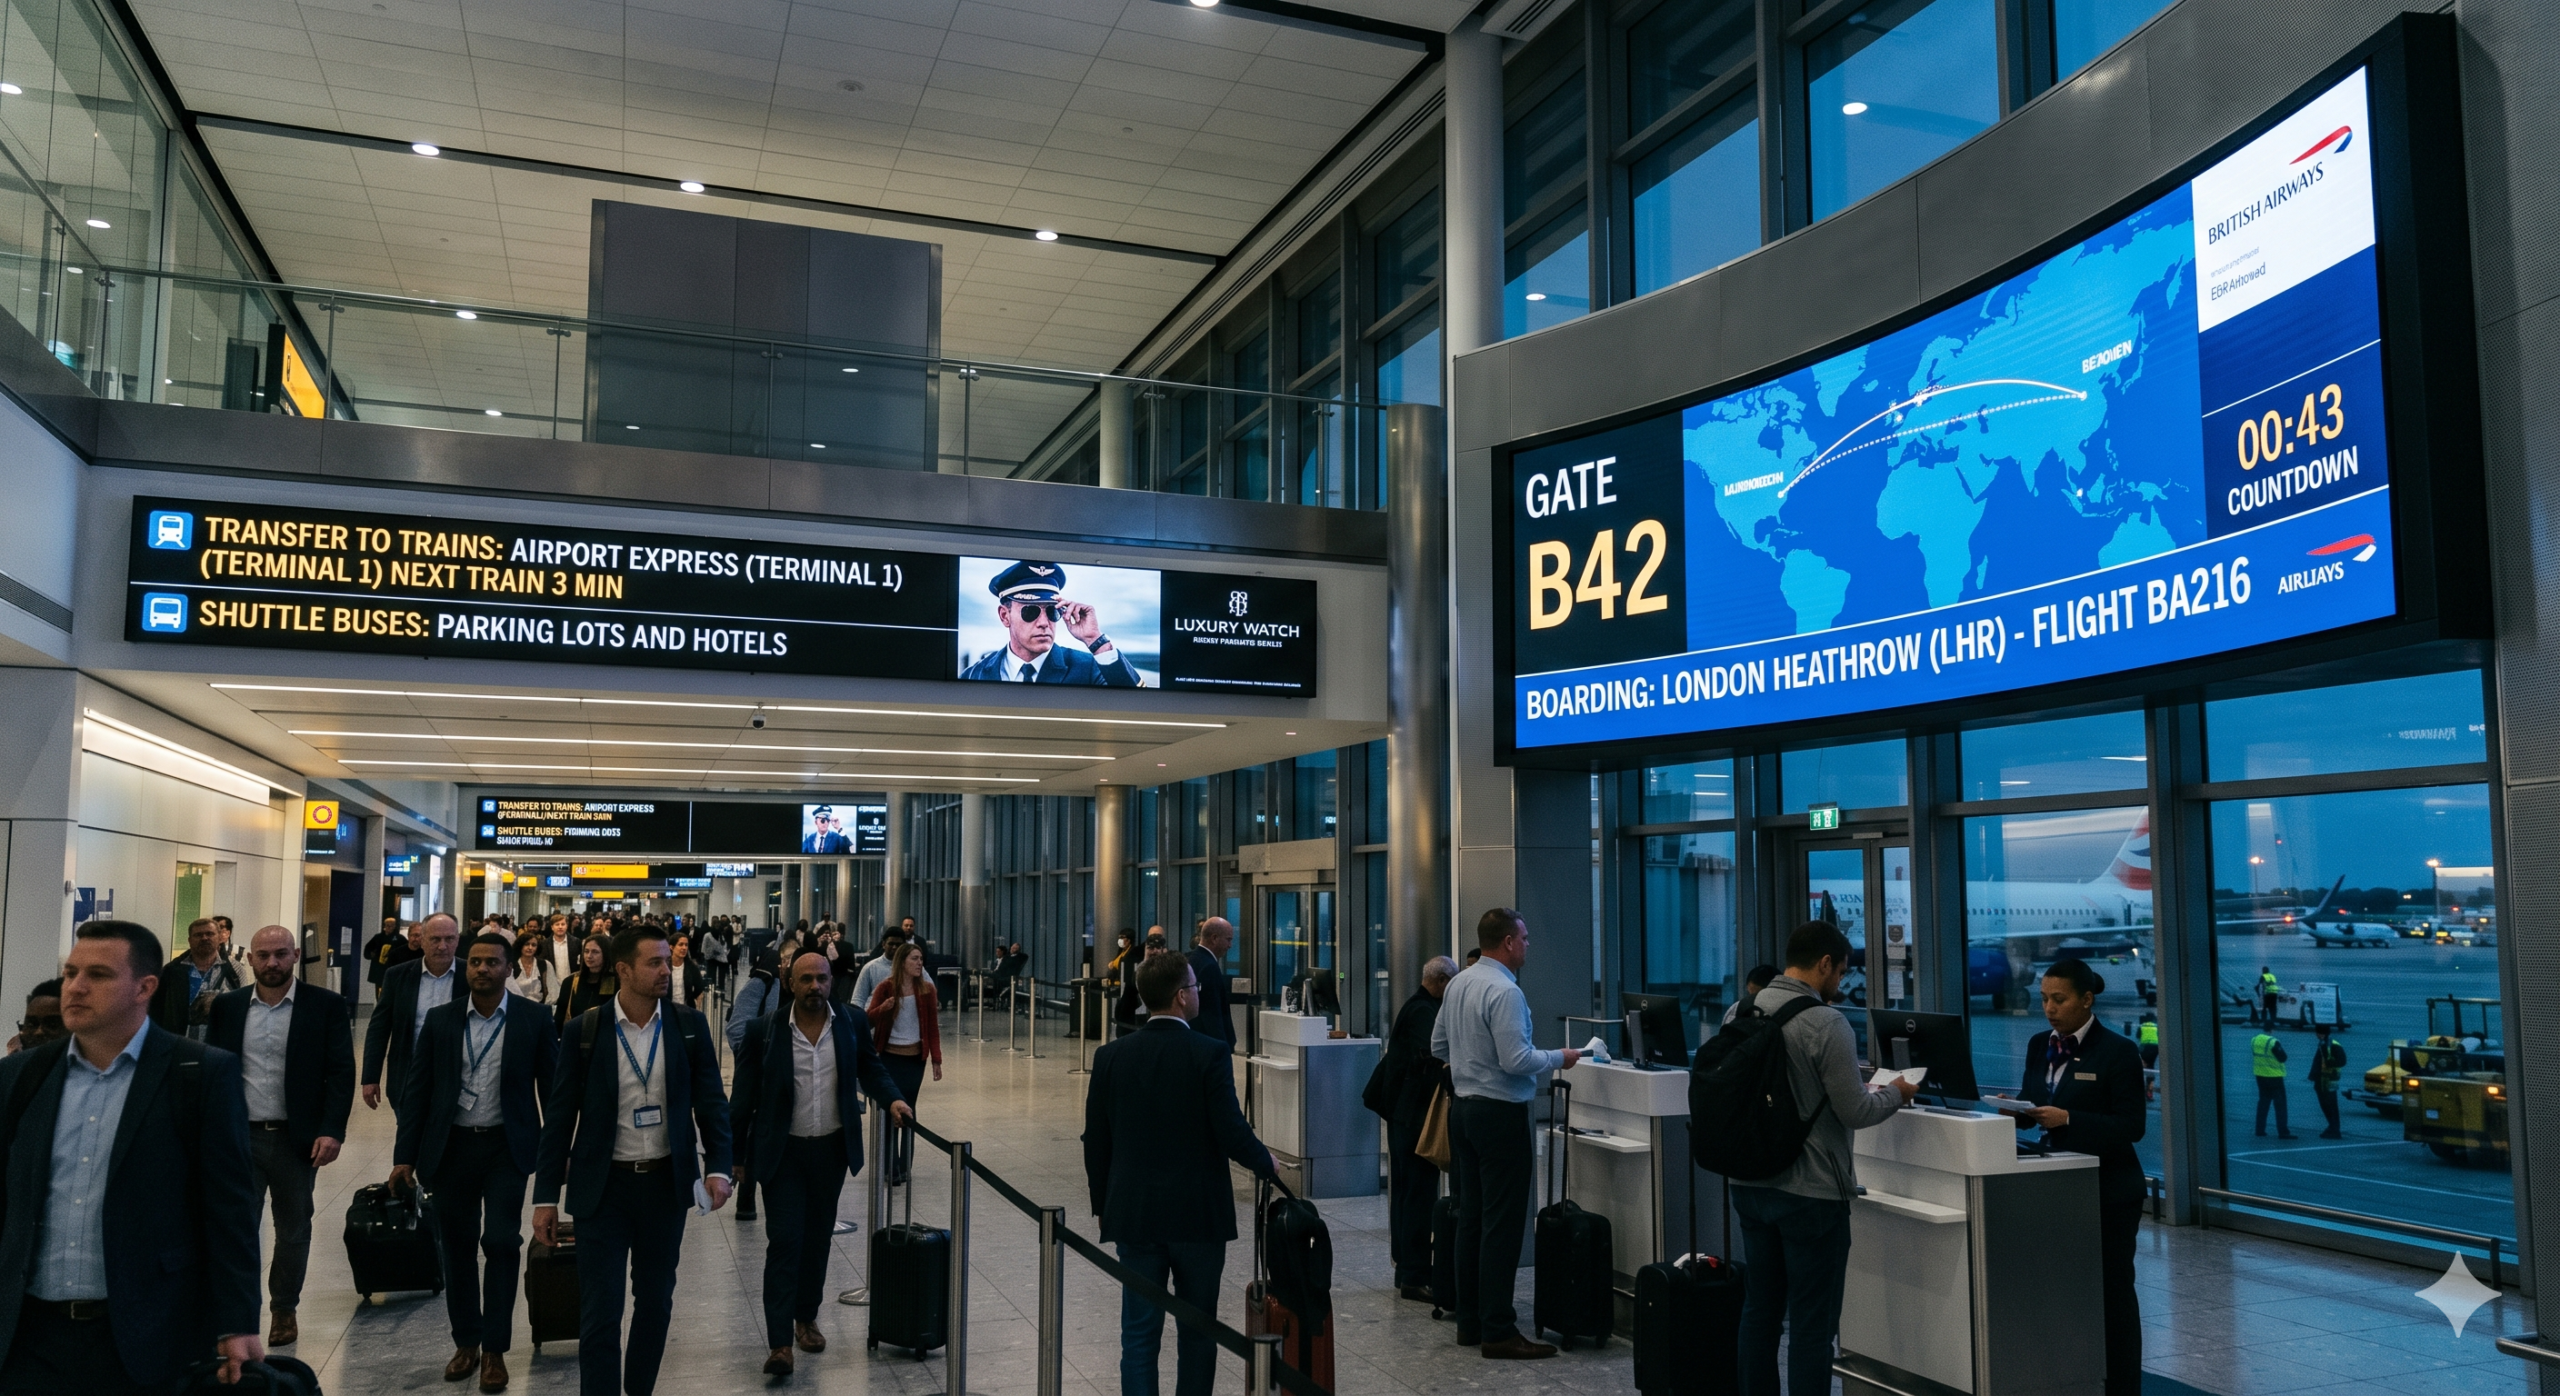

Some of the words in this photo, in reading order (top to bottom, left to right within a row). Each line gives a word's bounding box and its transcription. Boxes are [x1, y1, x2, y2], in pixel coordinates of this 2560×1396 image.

[2208, 200, 2261, 245] BRITISH
[2263, 161, 2324, 214] AIRWAYS
[2237, 383, 2345, 471] 00:43
[1525, 456, 1617, 519] GATE
[2227, 445, 2359, 516] COUNTDOWN
[201, 549, 352, 584] (TERMINAL
[359, 557, 383, 589] 1)
[391, 561, 460, 589] NEXT
[464, 565, 545, 594] TRAIN
[551, 571, 568, 595] 3
[575, 572, 623, 599] MIN
[205, 516, 348, 551] TRANSFER
[356, 527, 391, 553] TO
[399, 530, 503, 561] TRAINS:
[510, 537, 624, 568] AIRPORT
[629, 546, 738, 577] EXPRESS
[746, 553, 877, 588] (TERMINAL
[882, 563, 902, 592] 1)
[1529, 519, 1668, 631] B42
[199, 600, 325, 632] SHUTTLE
[333, 608, 430, 638] BUSES:
[438, 613, 553, 645] PARKING
[562, 620, 625, 648] LOTS
[631, 624, 686, 650] AND
[693, 626, 788, 656] HOTELS
[1174, 617, 1239, 634] LUXURY
[1243, 622, 1300, 638] WATCH
[1526, 675, 1655, 720] BOARDING:
[1662, 660, 1765, 706] LONDON
[1773, 632, 1922, 692] HEATHROW
[1930, 612, 2006, 675] (LHR)
[2014, 631, 2025, 640] -
[2033, 585, 2139, 648] FLIGHT
[2146, 556, 2252, 625] BA216
[497, 827, 533, 836] SHUTTLE
[498, 801, 539, 811] TRANSFER
[540, 802, 551, 811] TO
[618, 804, 655, 813] EXPRESS
